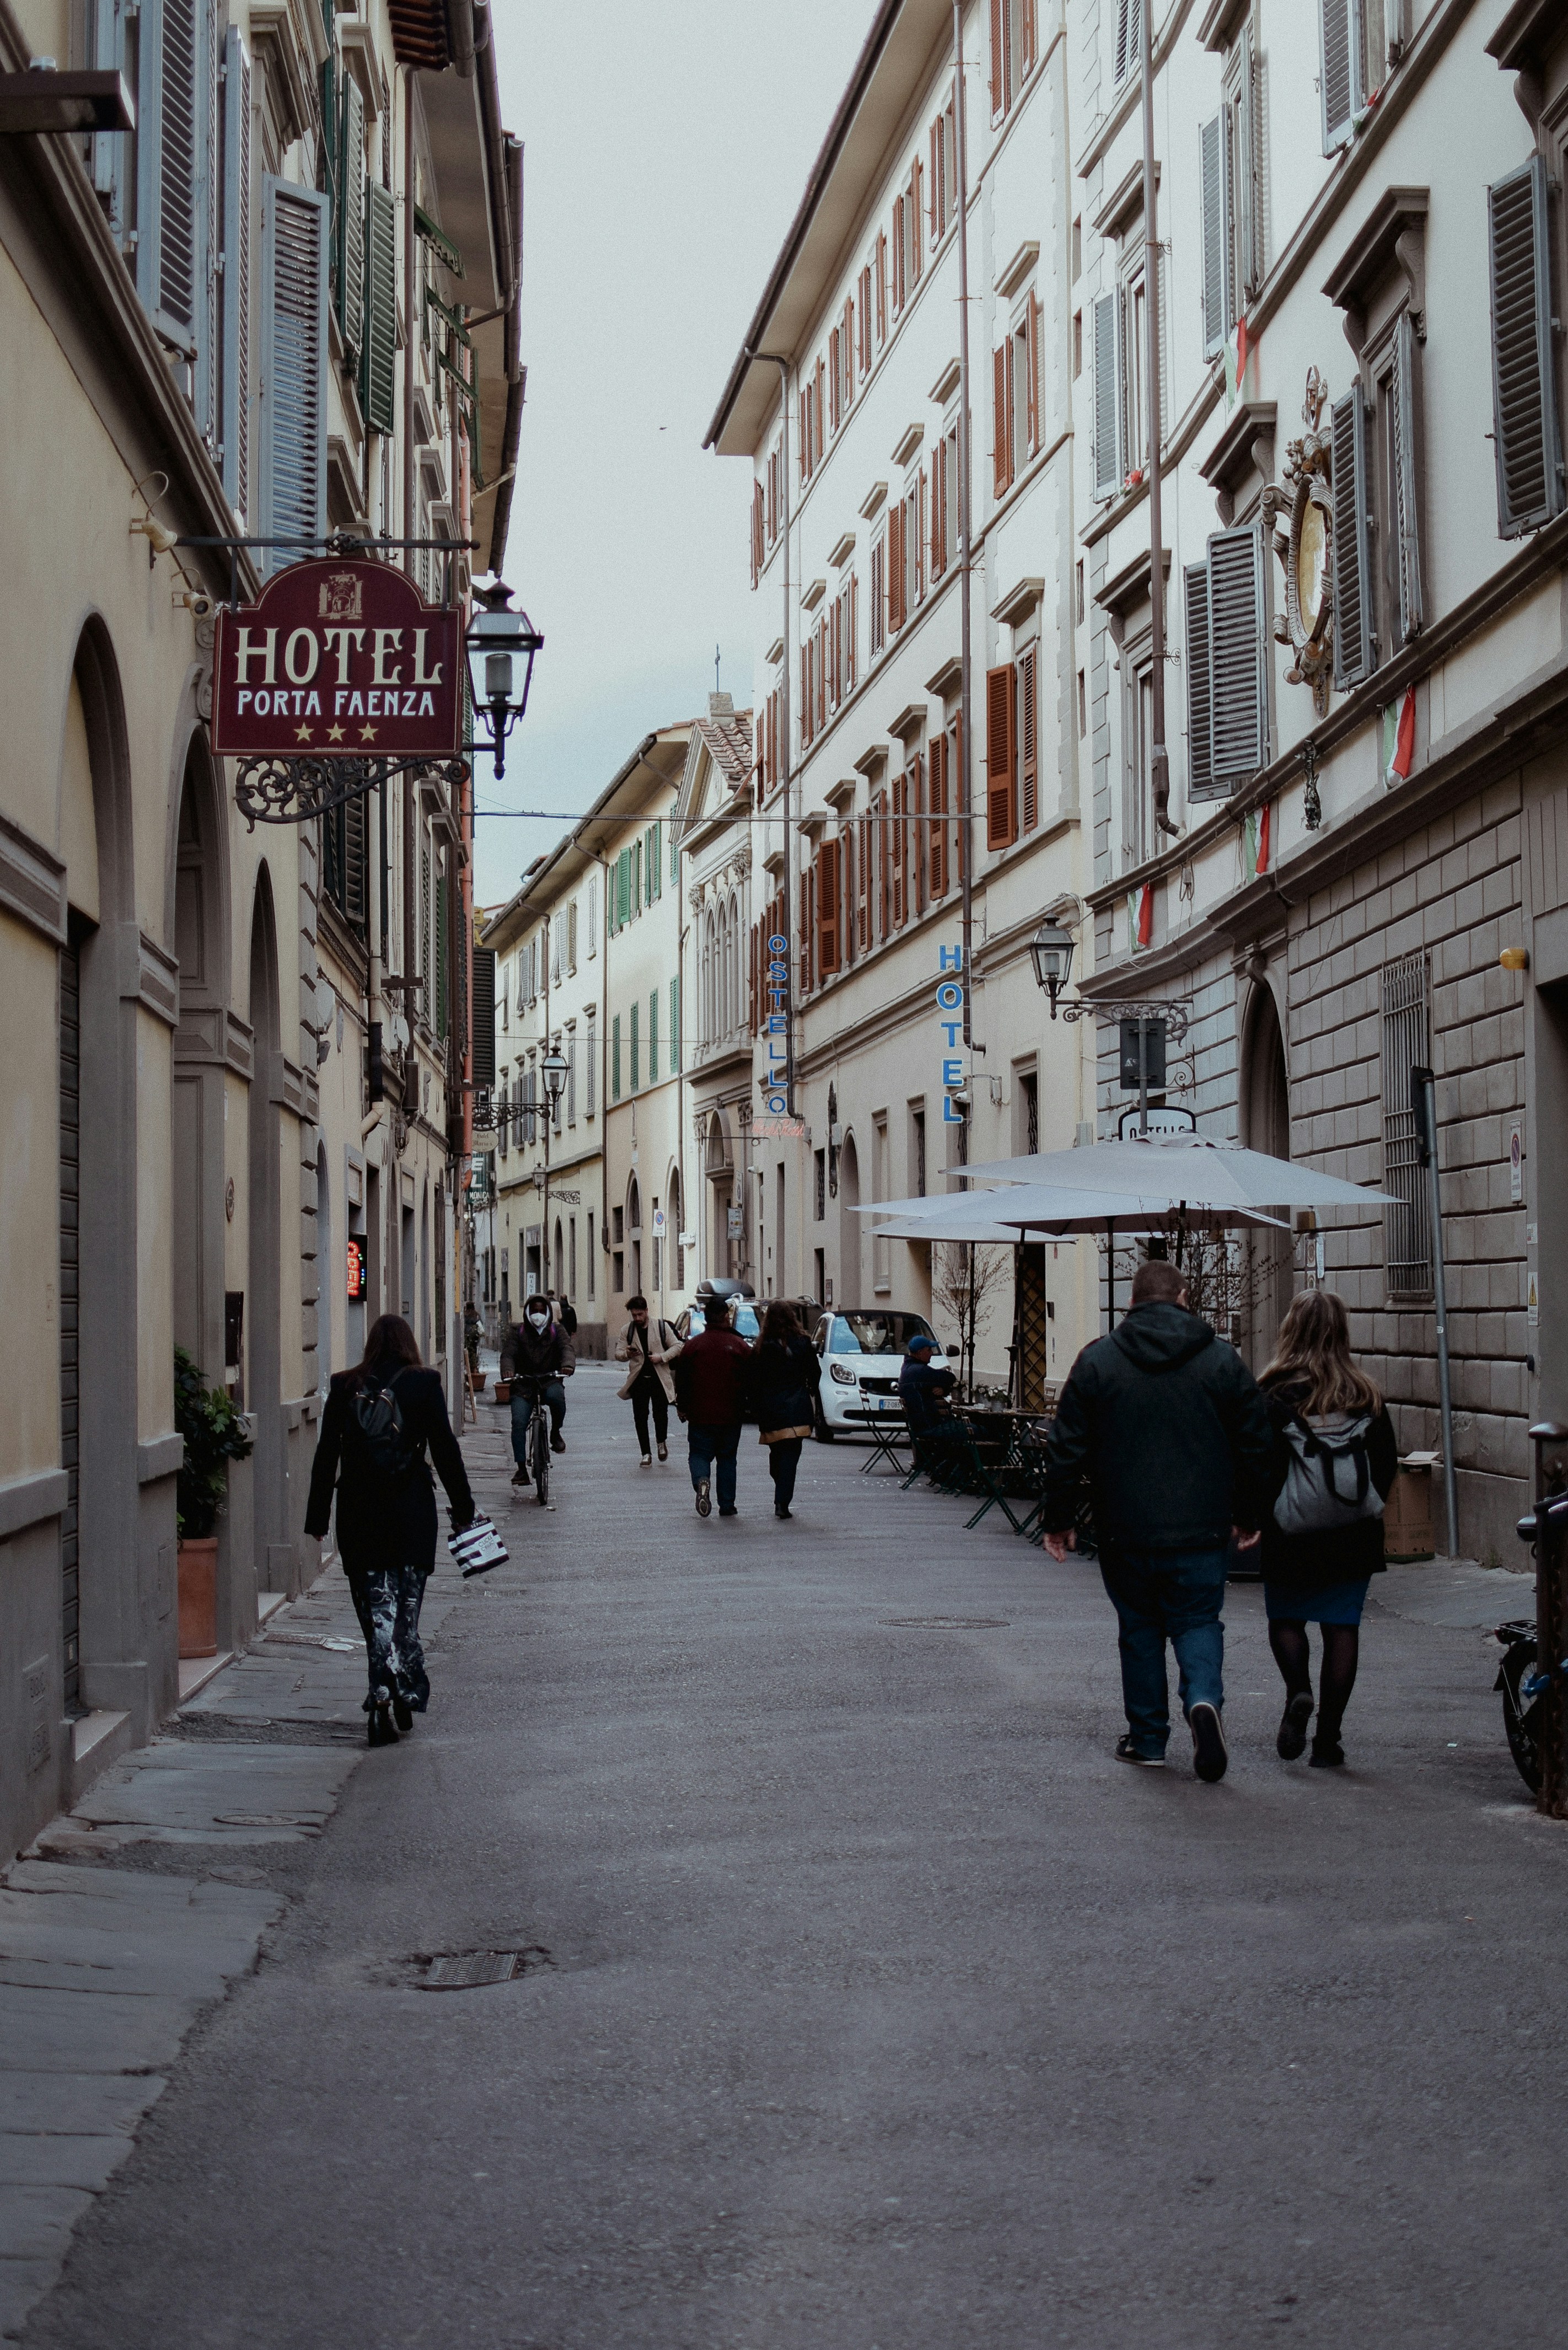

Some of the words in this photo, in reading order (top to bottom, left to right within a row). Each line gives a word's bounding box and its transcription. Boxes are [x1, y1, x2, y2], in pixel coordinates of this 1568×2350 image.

[234, 627, 443, 684] HOTEL
[238, 691, 321, 715] PORTA
[335, 691, 435, 715] FAENZA
[768, 935, 787, 1113] OSTELLO
[936, 944, 963, 1123] HOTEL
